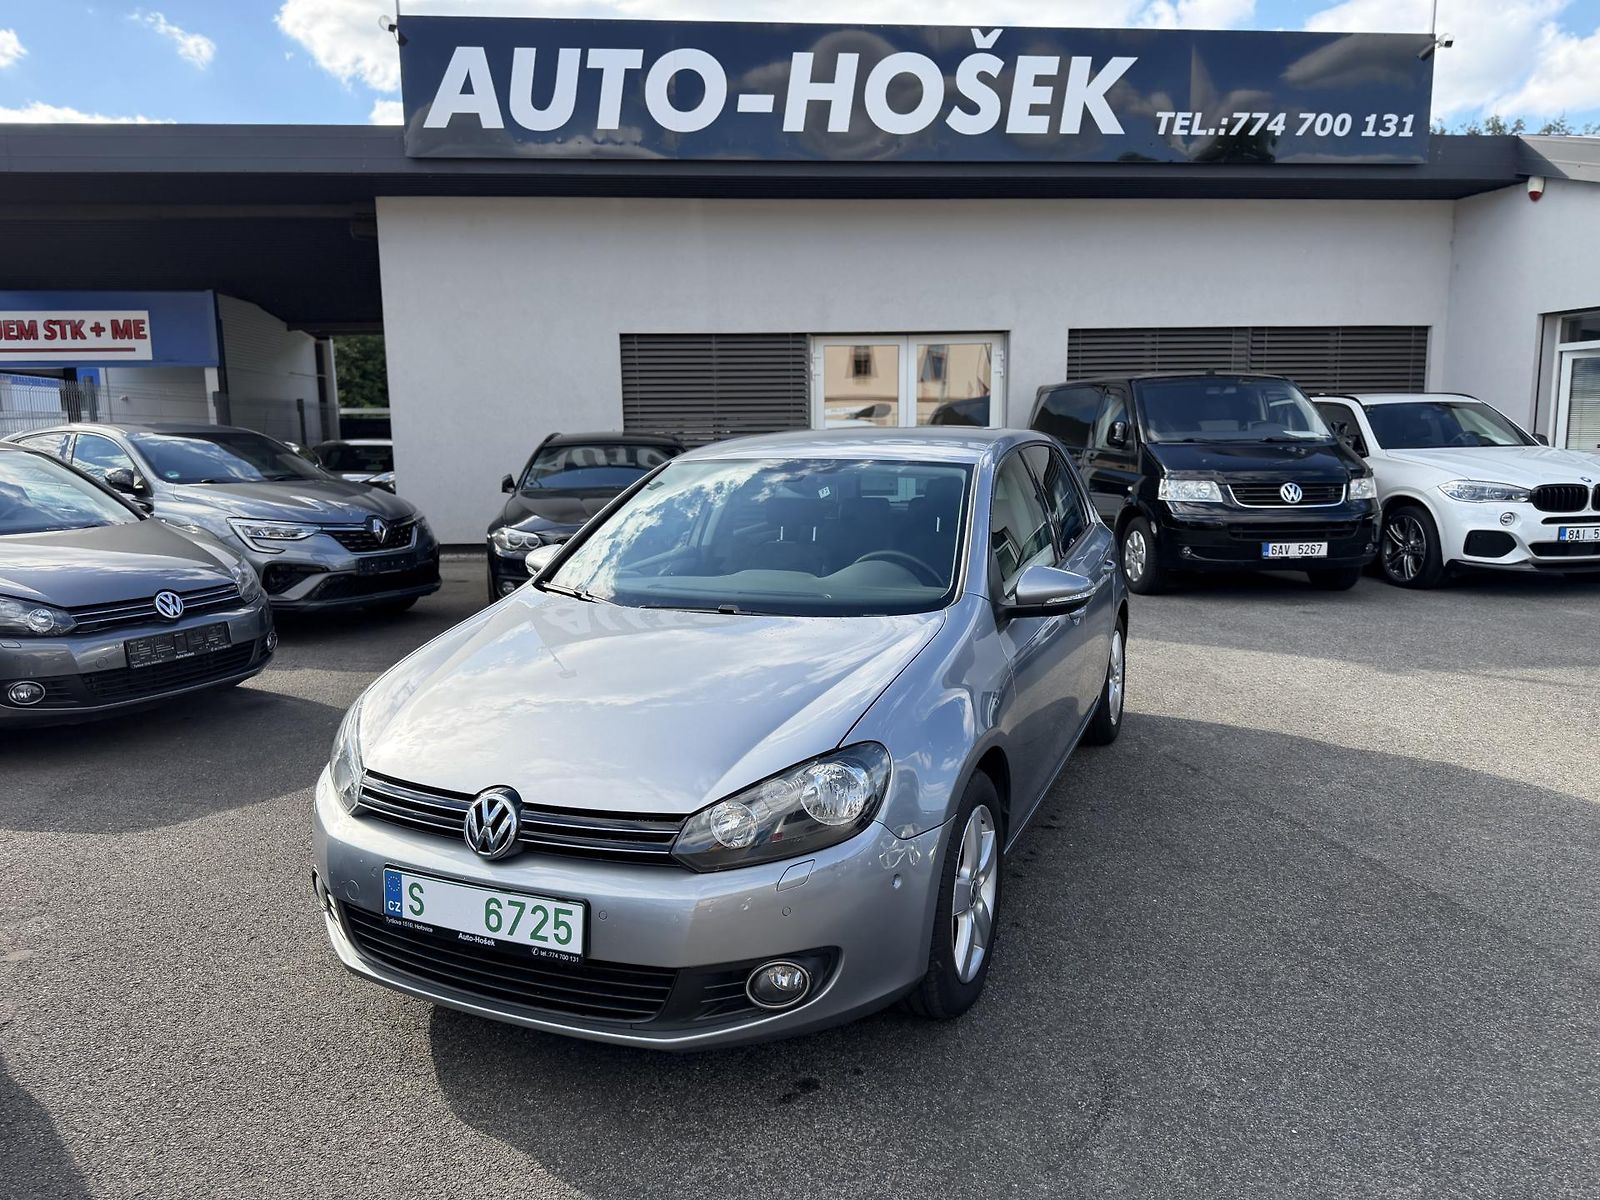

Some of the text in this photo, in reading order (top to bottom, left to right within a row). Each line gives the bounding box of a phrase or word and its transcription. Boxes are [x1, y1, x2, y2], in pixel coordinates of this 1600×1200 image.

[423, 28, 1138, 136] AUTO-HOŠEK
[1156, 112, 1415, 137] TEL.:774 700 131
[43, 319, 87, 340] STK
[110, 319, 148, 340] ME
[1271, 544, 1291, 556] 6AV
[1298, 543, 1323, 555] 5267
[388, 900, 402, 913] CZ
[408, 882, 573, 946] S 6725
[458, 932, 496, 947] Auto-Hošek
[559, 953, 569, 961] 700
[570, 955, 579, 963] 131
